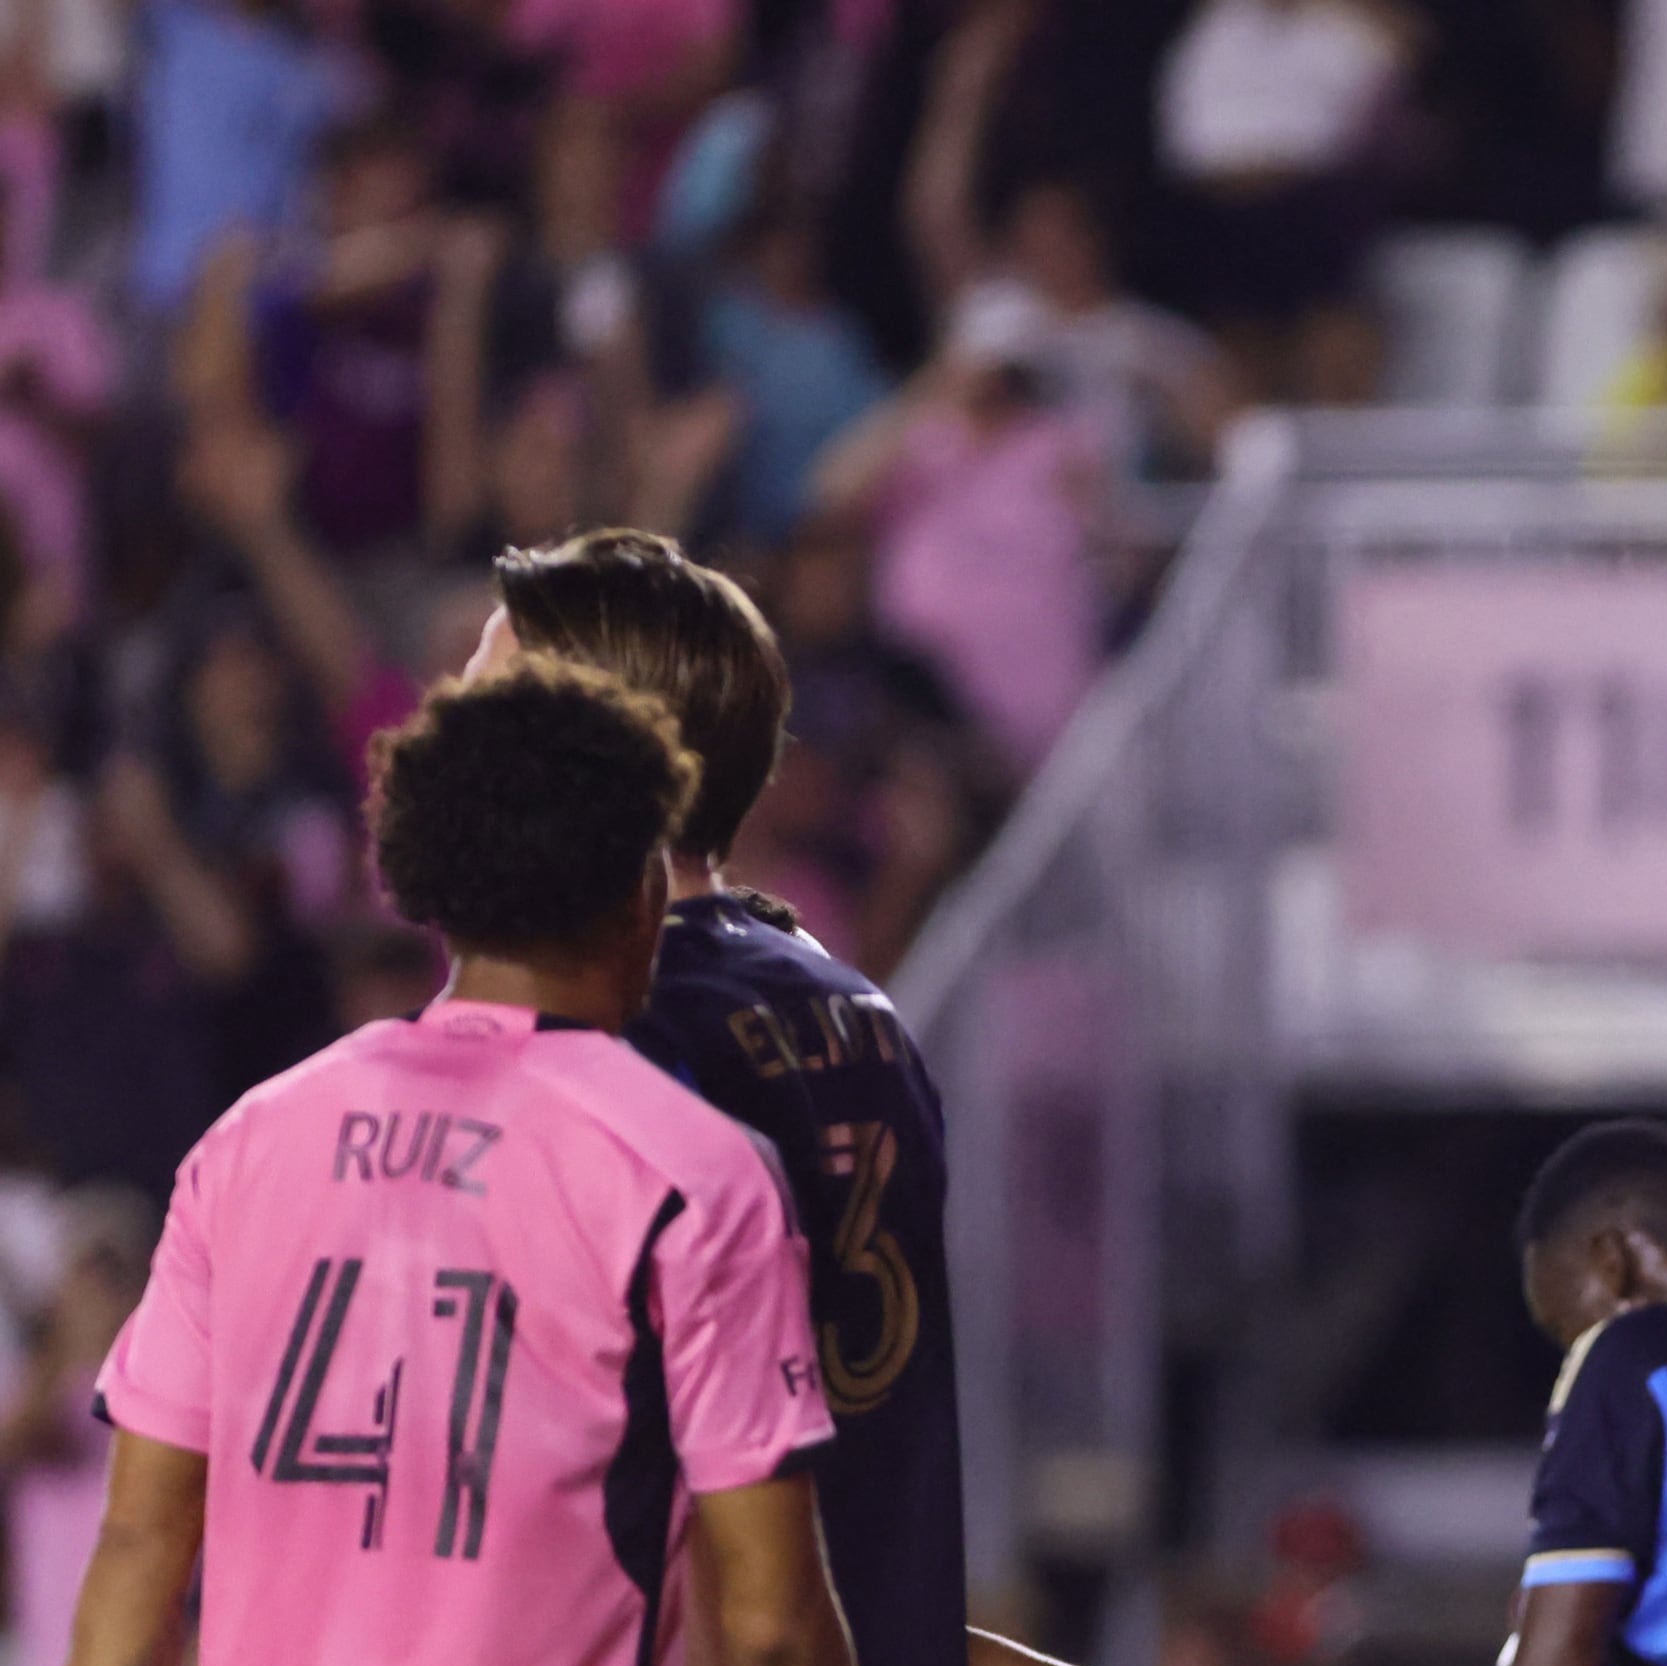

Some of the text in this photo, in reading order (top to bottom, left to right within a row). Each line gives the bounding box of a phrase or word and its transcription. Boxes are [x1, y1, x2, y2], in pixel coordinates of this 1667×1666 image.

[333, 1110, 503, 1197] RUIZ
[818, 1120, 919, 1415] 3
[251, 1257, 520, 1561] 41
